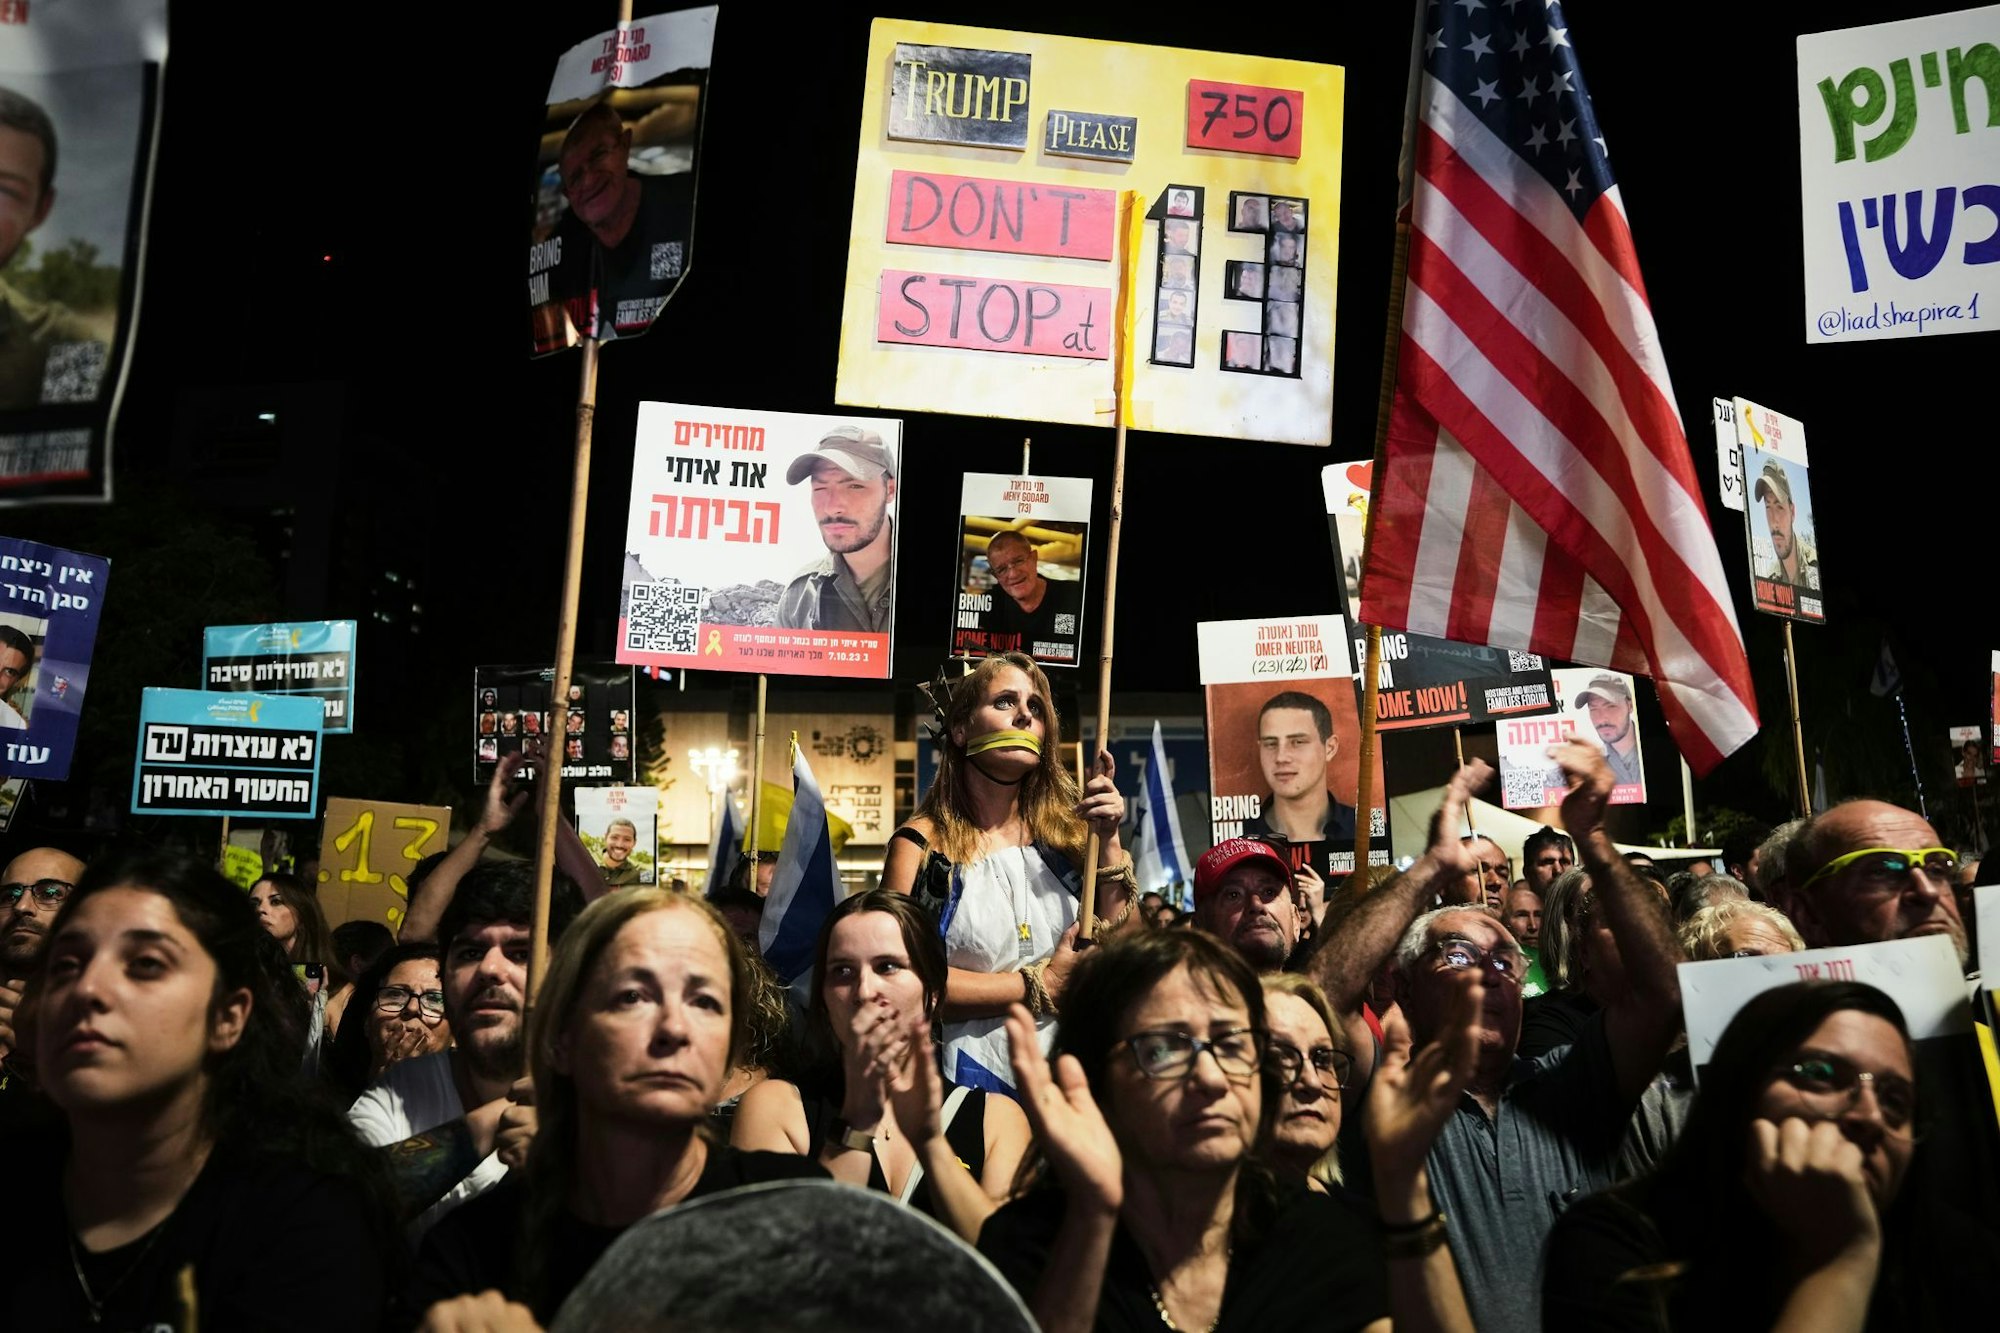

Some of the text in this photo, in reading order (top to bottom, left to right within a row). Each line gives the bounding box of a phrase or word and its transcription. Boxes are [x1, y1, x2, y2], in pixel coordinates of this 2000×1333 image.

[899, 60, 1028, 123] TRUMP
[1200, 91, 1292, 143] 750
[1051, 112, 1131, 153] PLEASE
[902, 176, 1086, 247] DON'T
[530, 236, 562, 275] BRING
[529, 271, 550, 306] HIM
[1145, 183, 1309, 380] 13
[895, 276, 1097, 352] STOP at
[1818, 292, 1980, 336] @liadshapira1
[674, 420, 765, 451] מחזירים
[665, 456, 767, 488] את איתי
[1003, 491, 1020, 501] MENY
[1034, 481, 1044, 492] מני
[648, 493, 780, 544] הביתה
[1018, 502, 1031, 514] (73)
[58, 566, 94, 584] אין
[3, 582, 89, 611] סגן הדר
[958, 592, 993, 612] BRING
[957, 610, 980, 629] HIM
[1257, 623, 1318, 641] עומר נאוטרה
[841, 638, 858, 648] איתי
[955, 630, 1022, 652] HOME NOW!
[1256, 639, 1323, 657] OMER NEUTRA
[1355, 633, 1409, 662] BING
[322, 658, 346, 679] לא
[828, 651, 861, 662] 7.10.23
[1252, 659, 1280, 676] (23)
[1415, 680, 1469, 714] NOW!
[1486, 695, 1521, 710] FAMILIES
[1521, 692, 1549, 706] FORUM
[6, 742, 51, 765] עוז
[151, 730, 313, 761] לא עוצרות עד
[143, 773, 310, 804] החטוף האחרון
[1211, 794, 1260, 821] BRING
[1212, 820, 1244, 847] HIM
[1329, 860, 1355, 873] FAMILI
